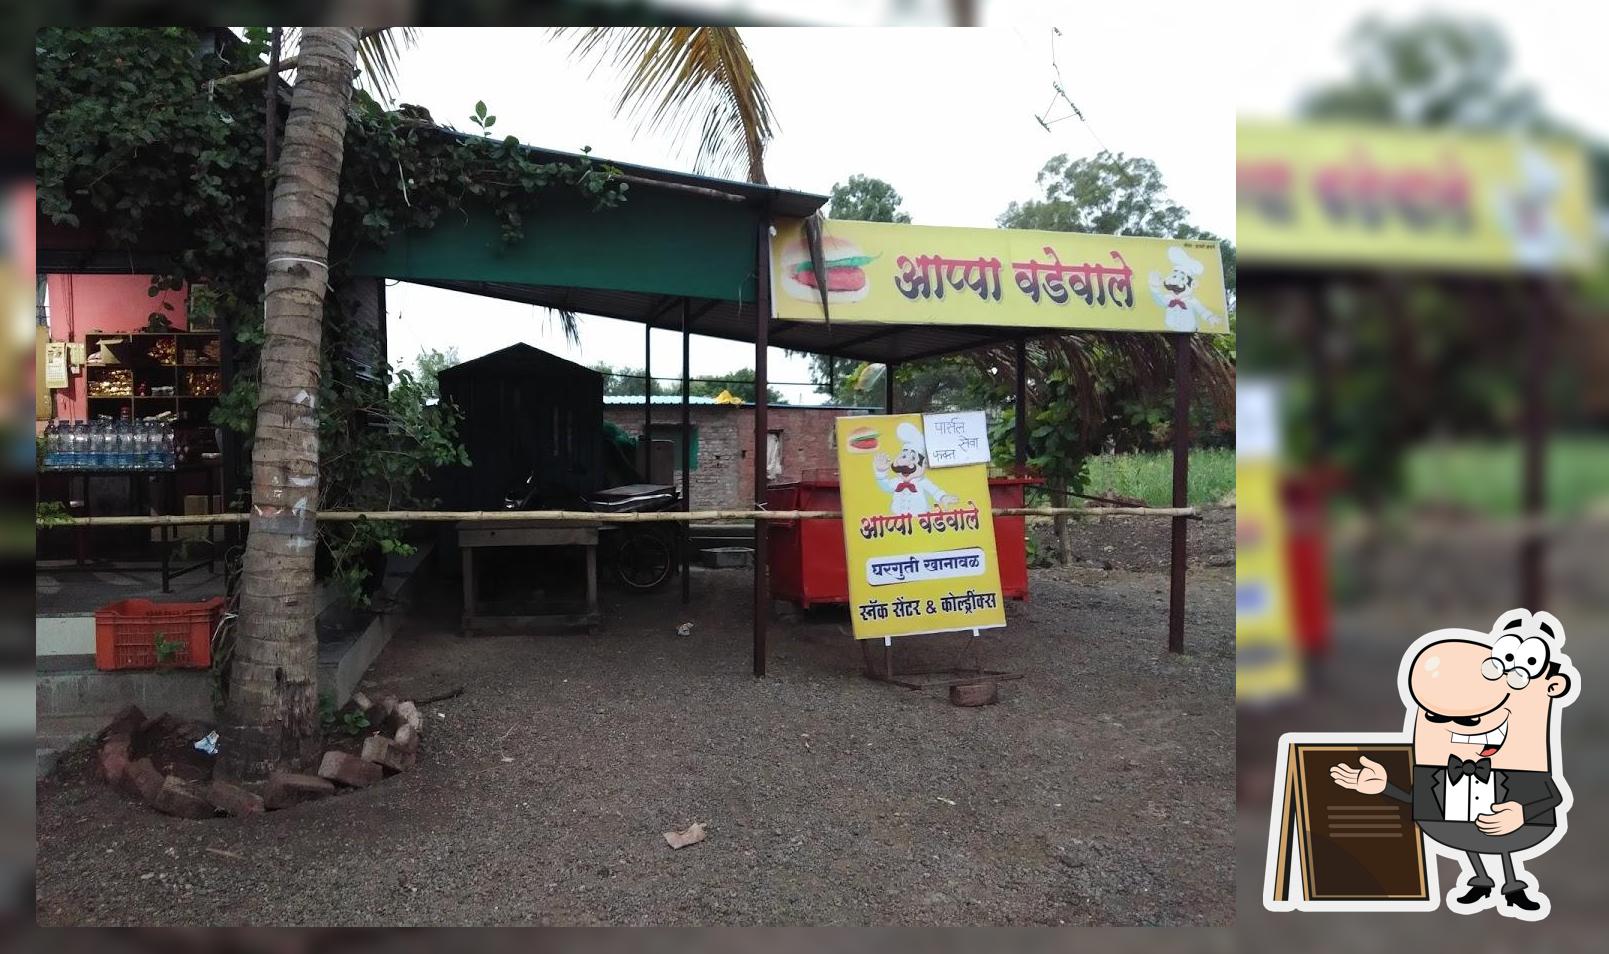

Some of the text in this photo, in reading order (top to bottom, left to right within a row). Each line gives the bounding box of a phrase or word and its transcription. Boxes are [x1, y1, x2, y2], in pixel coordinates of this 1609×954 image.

[894, 246, 1135, 308] आप्पा वडेवाले
[860, 500, 980, 540] आप्पा वडेवाले
[872, 554, 980, 580] घरगुती खानावळ
[926, 600, 937, 614] &
